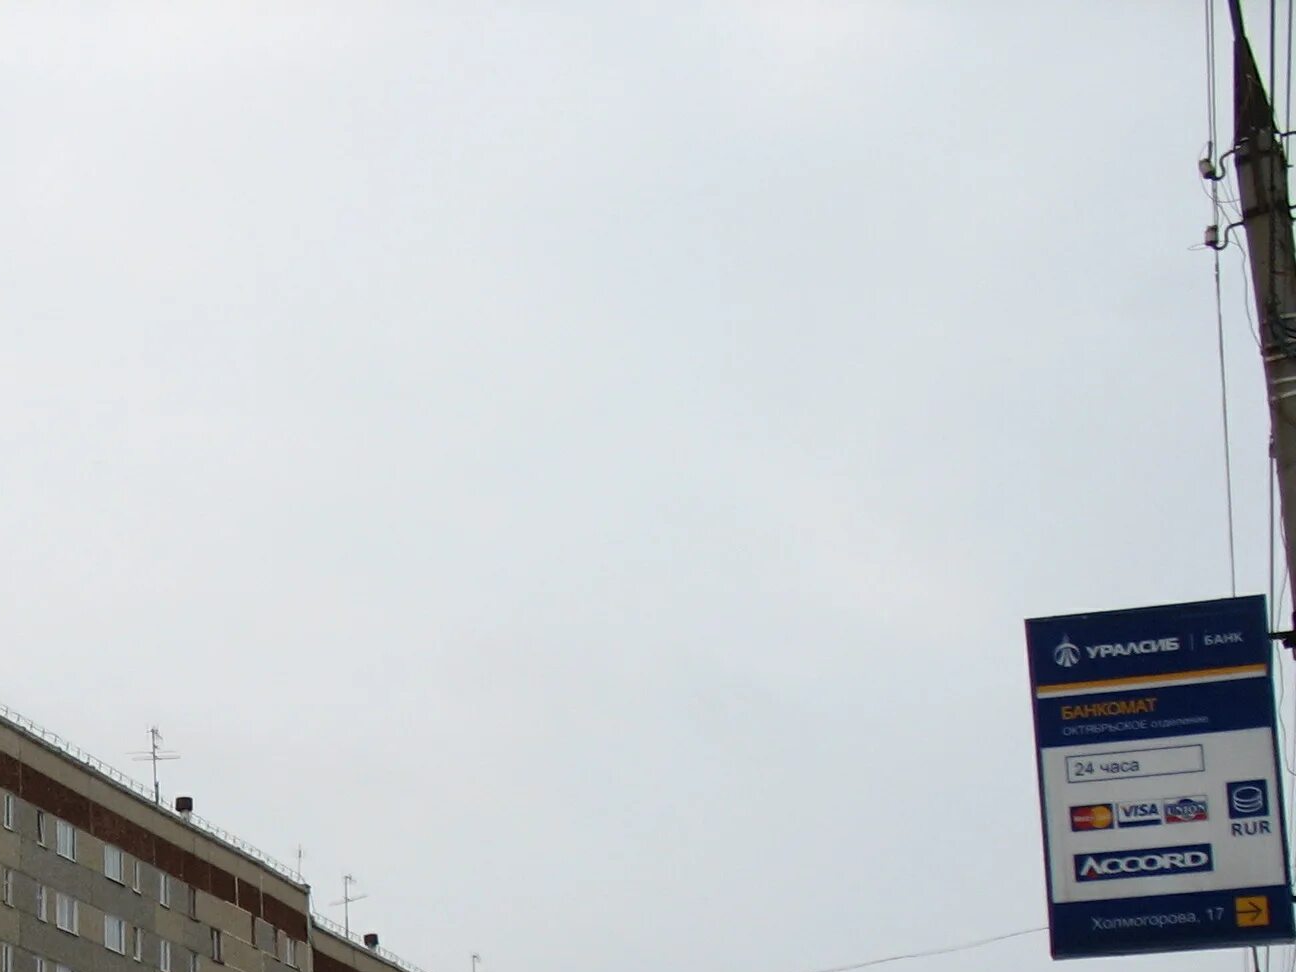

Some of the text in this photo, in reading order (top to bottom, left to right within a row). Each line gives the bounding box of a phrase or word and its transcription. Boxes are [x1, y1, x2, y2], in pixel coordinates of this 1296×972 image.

[1086, 631, 1243, 660] УРАЛСИБ БАНК
[1061, 698, 1157, 720] БАНКОМАТ
[1074, 760, 1140, 776] 24 часа
[1122, 803, 1159, 817] VISA
[1232, 820, 1271, 836] RUR
[1080, 851, 1208, 877] ACCORD
[1205, 907, 1224, 921] 17
